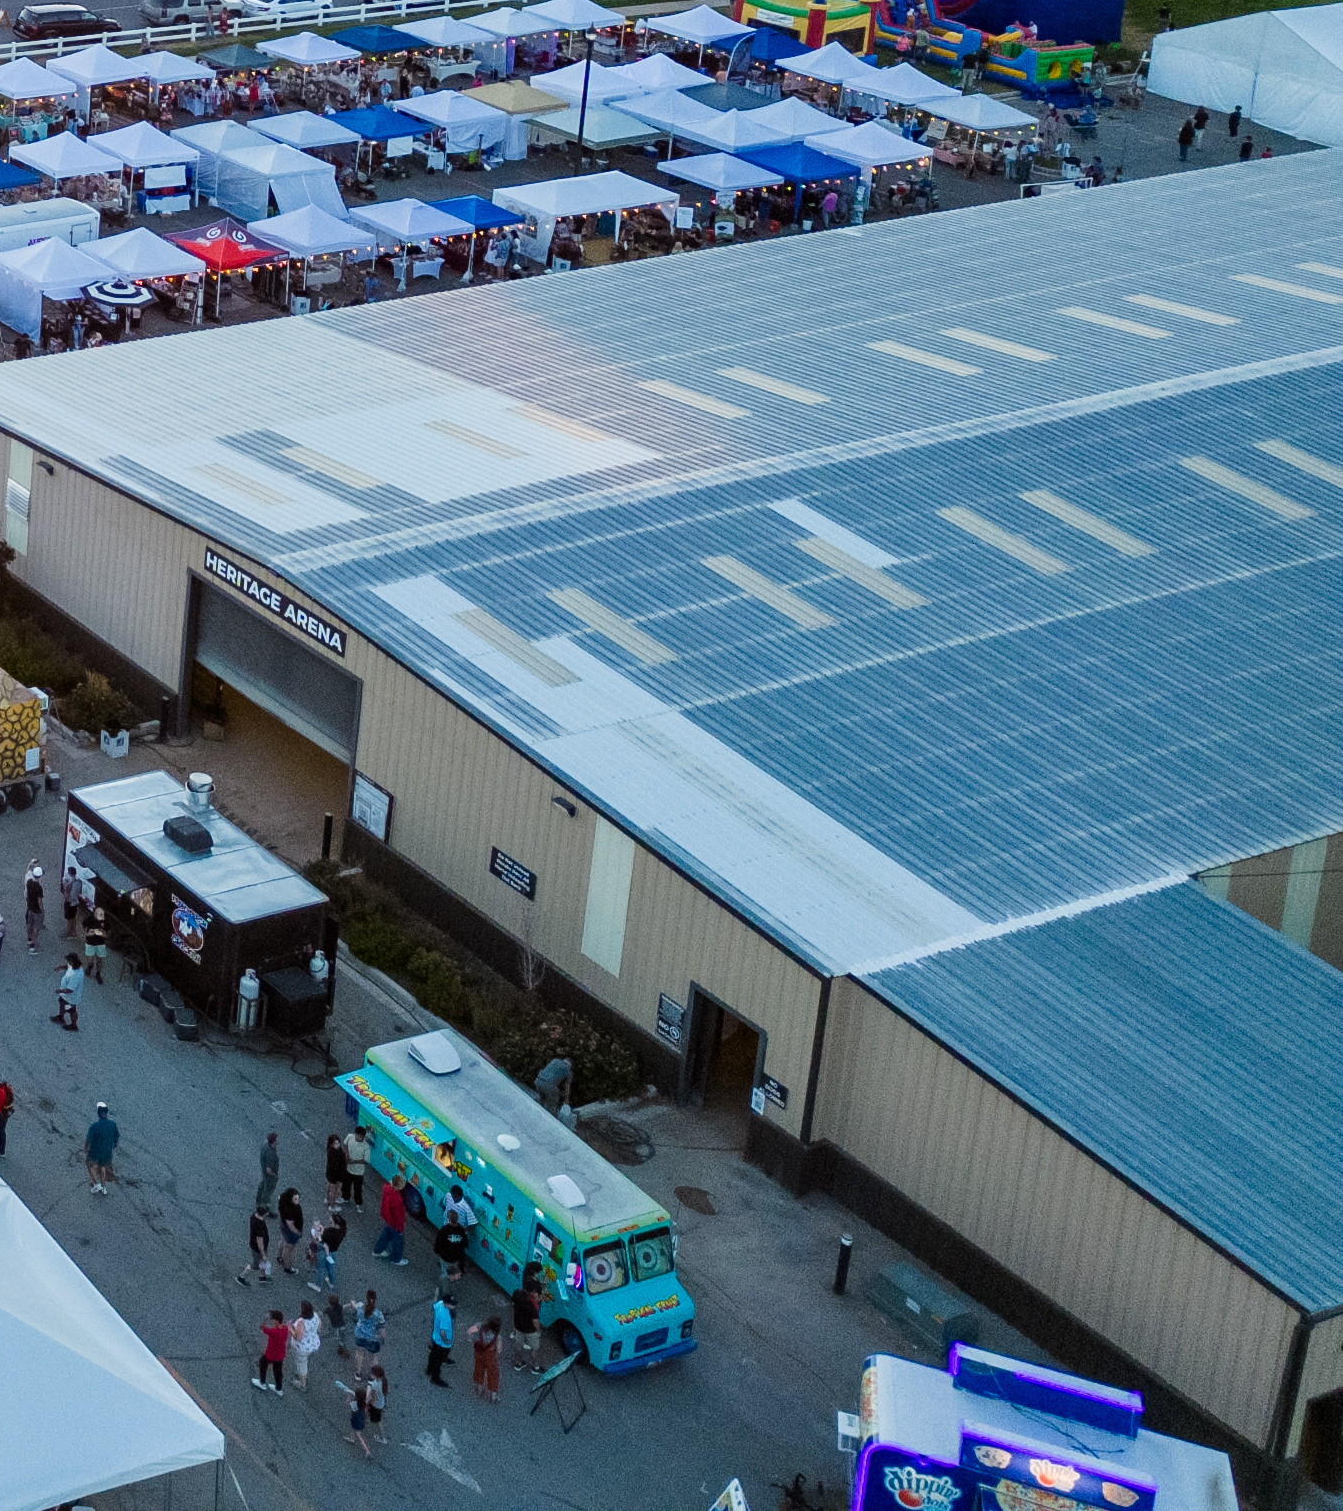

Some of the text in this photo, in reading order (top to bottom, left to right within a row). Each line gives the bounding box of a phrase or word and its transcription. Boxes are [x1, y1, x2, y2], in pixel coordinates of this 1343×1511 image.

[206, 551, 343, 653] HERITAGE ARENA
[513, 863, 530, 878] Unload
[658, 1019, 670, 1031] NO
[764, 1083, 781, 1098] DOGS
[769, 1079, 778, 1089] NO
[884, 1466, 961, 1500] dippin'
